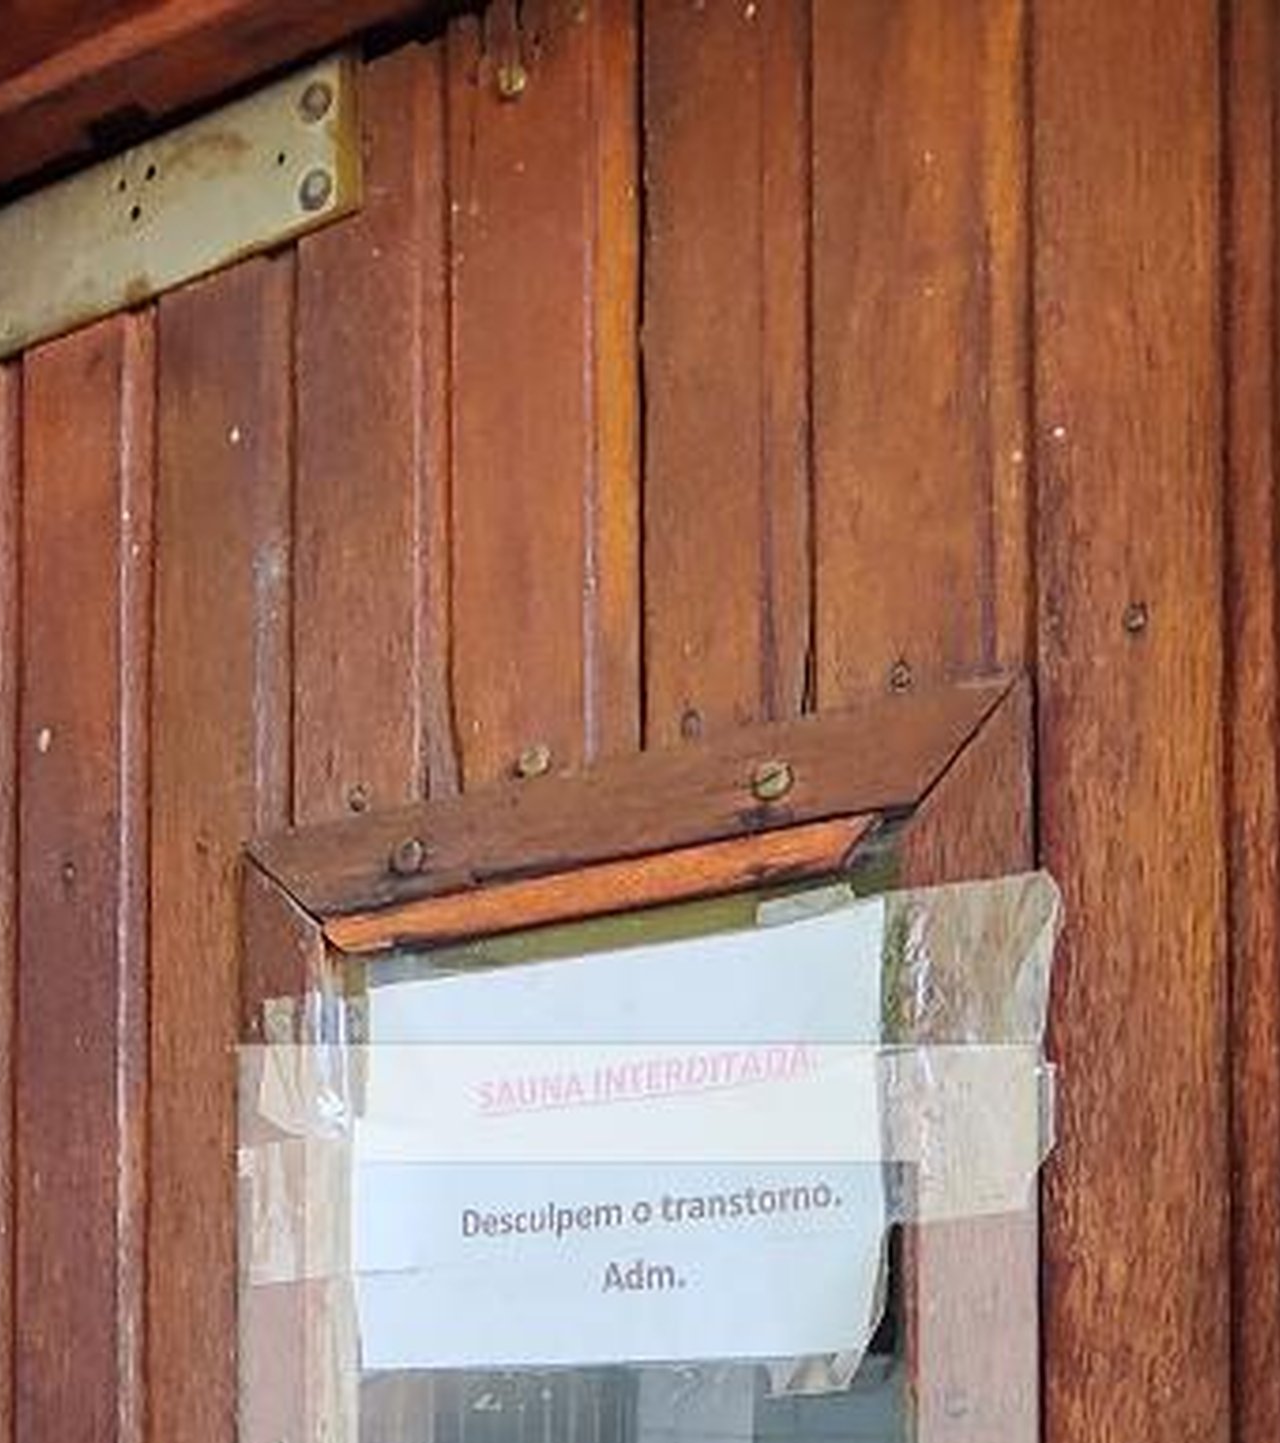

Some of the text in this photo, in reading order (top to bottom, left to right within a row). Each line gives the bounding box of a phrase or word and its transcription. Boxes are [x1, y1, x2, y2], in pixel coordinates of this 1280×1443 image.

[478, 1076, 586, 1110] SAUNA
[462, 1184, 843, 1239] Desculpem o transtorno.
[602, 1259, 687, 1292] Adm.
